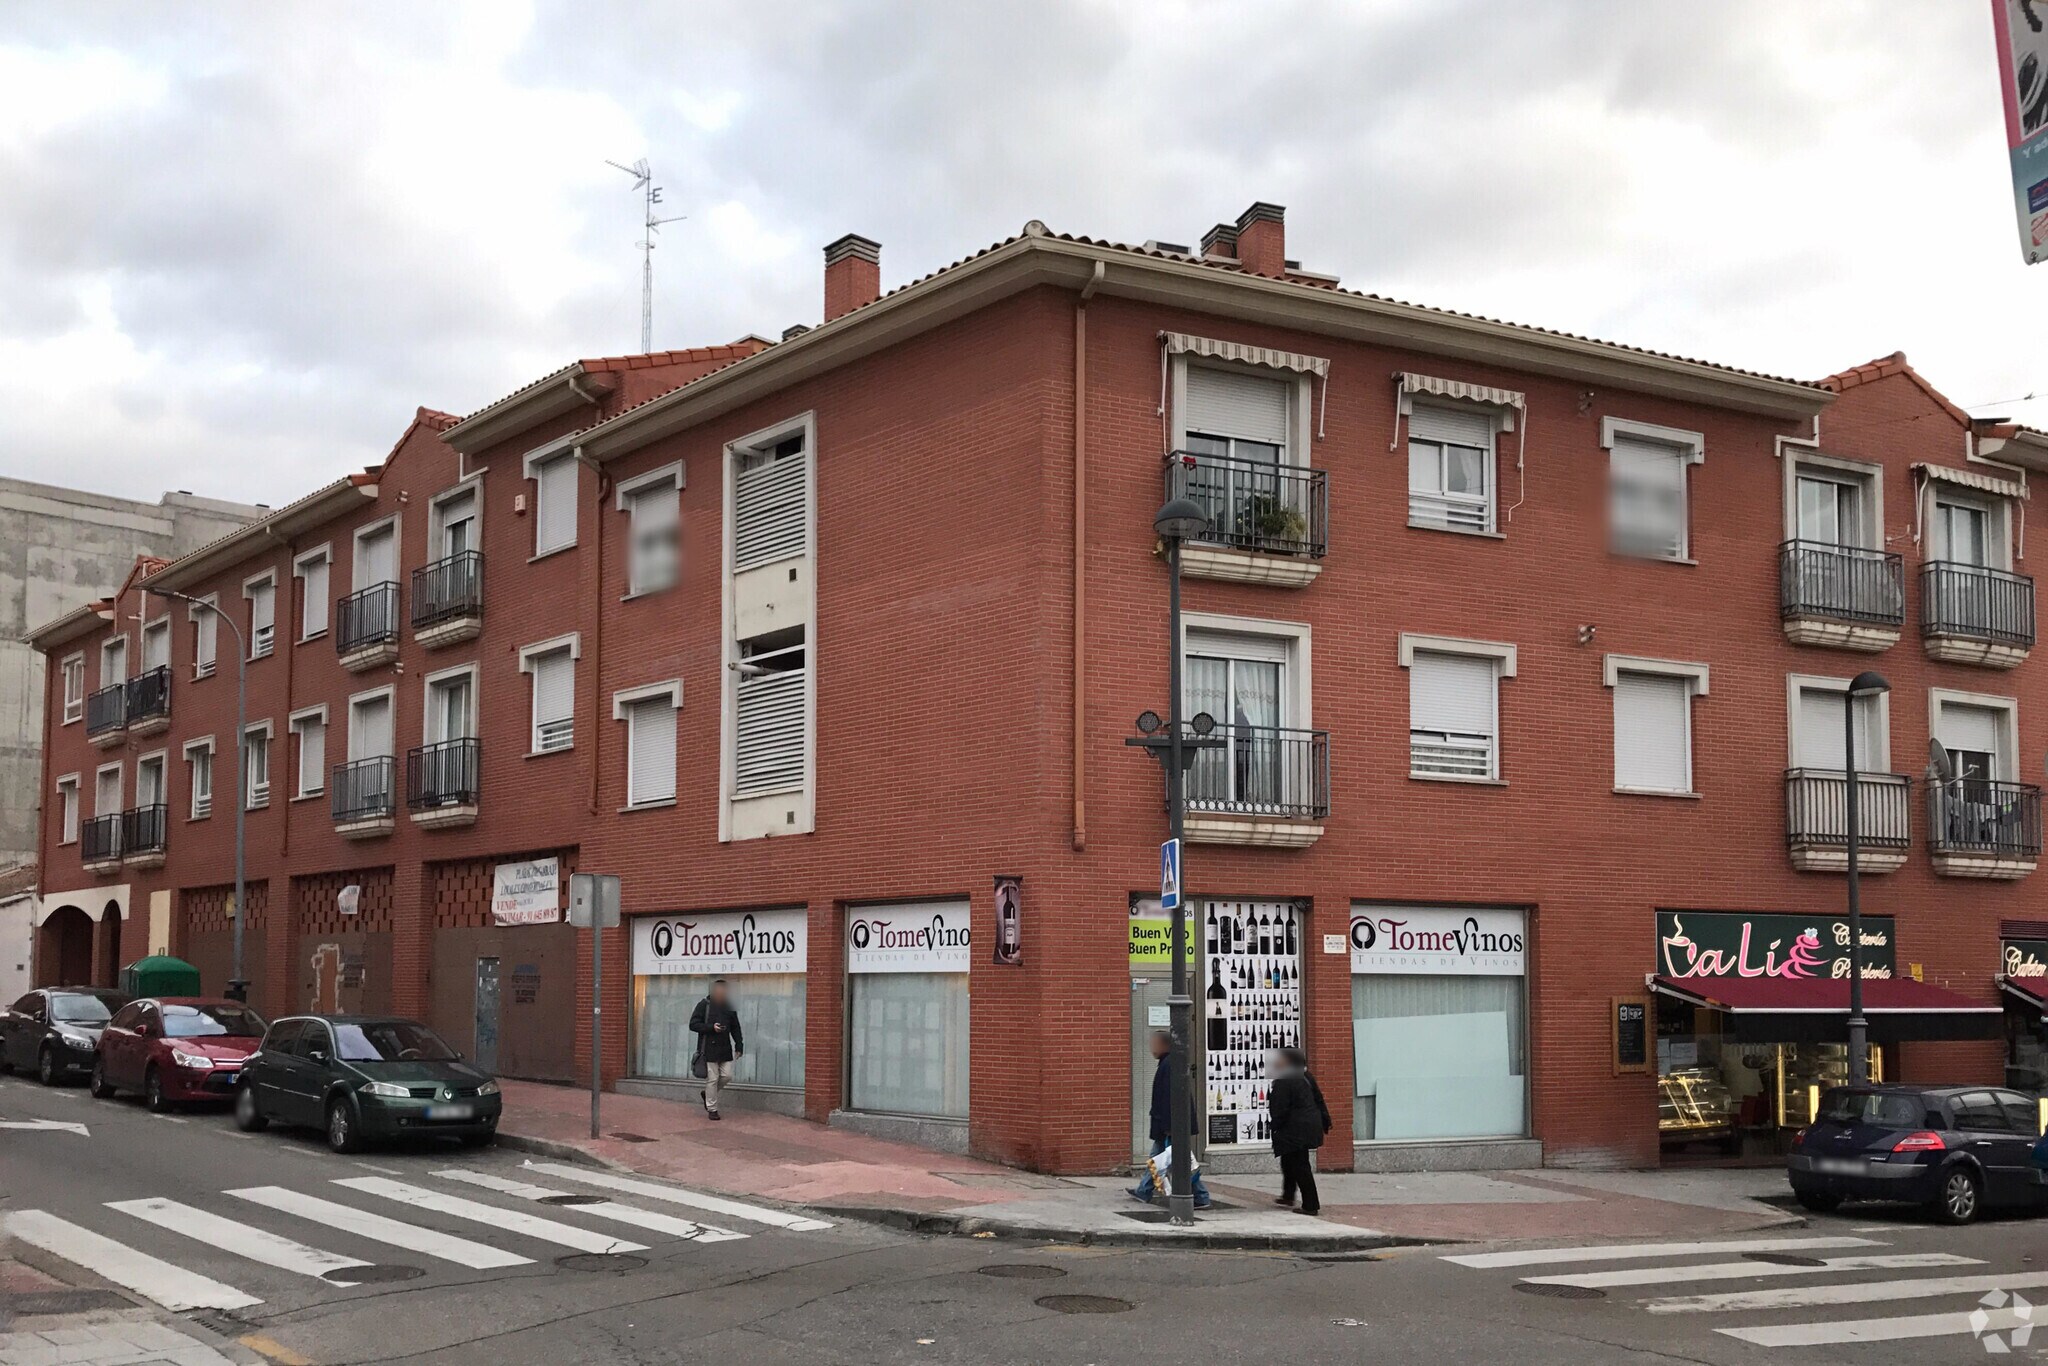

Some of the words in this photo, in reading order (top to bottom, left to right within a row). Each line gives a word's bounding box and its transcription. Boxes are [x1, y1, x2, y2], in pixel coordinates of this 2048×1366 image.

[2022, 146, 2031, 158] Y
[674, 914, 795, 960] TomeVinos
[1132, 926, 1161, 939] Buen
[1163, 926, 1190, 940] Vo
[1378, 917, 1523, 956] TomeVinos
[1832, 922, 1888, 951] Ctería
[1129, 942, 1157, 955] Buen
[1159, 942, 1195, 956] Pro
[658, 962, 711, 973] TIENDAS
[721, 963, 735, 972] DE
[747, 961, 790, 972] VINOS
[1356, 954, 1426, 966] TIENDAS
[1469, 956, 1518, 967] VINOS
[1831, 957, 1892, 979] Pelería
